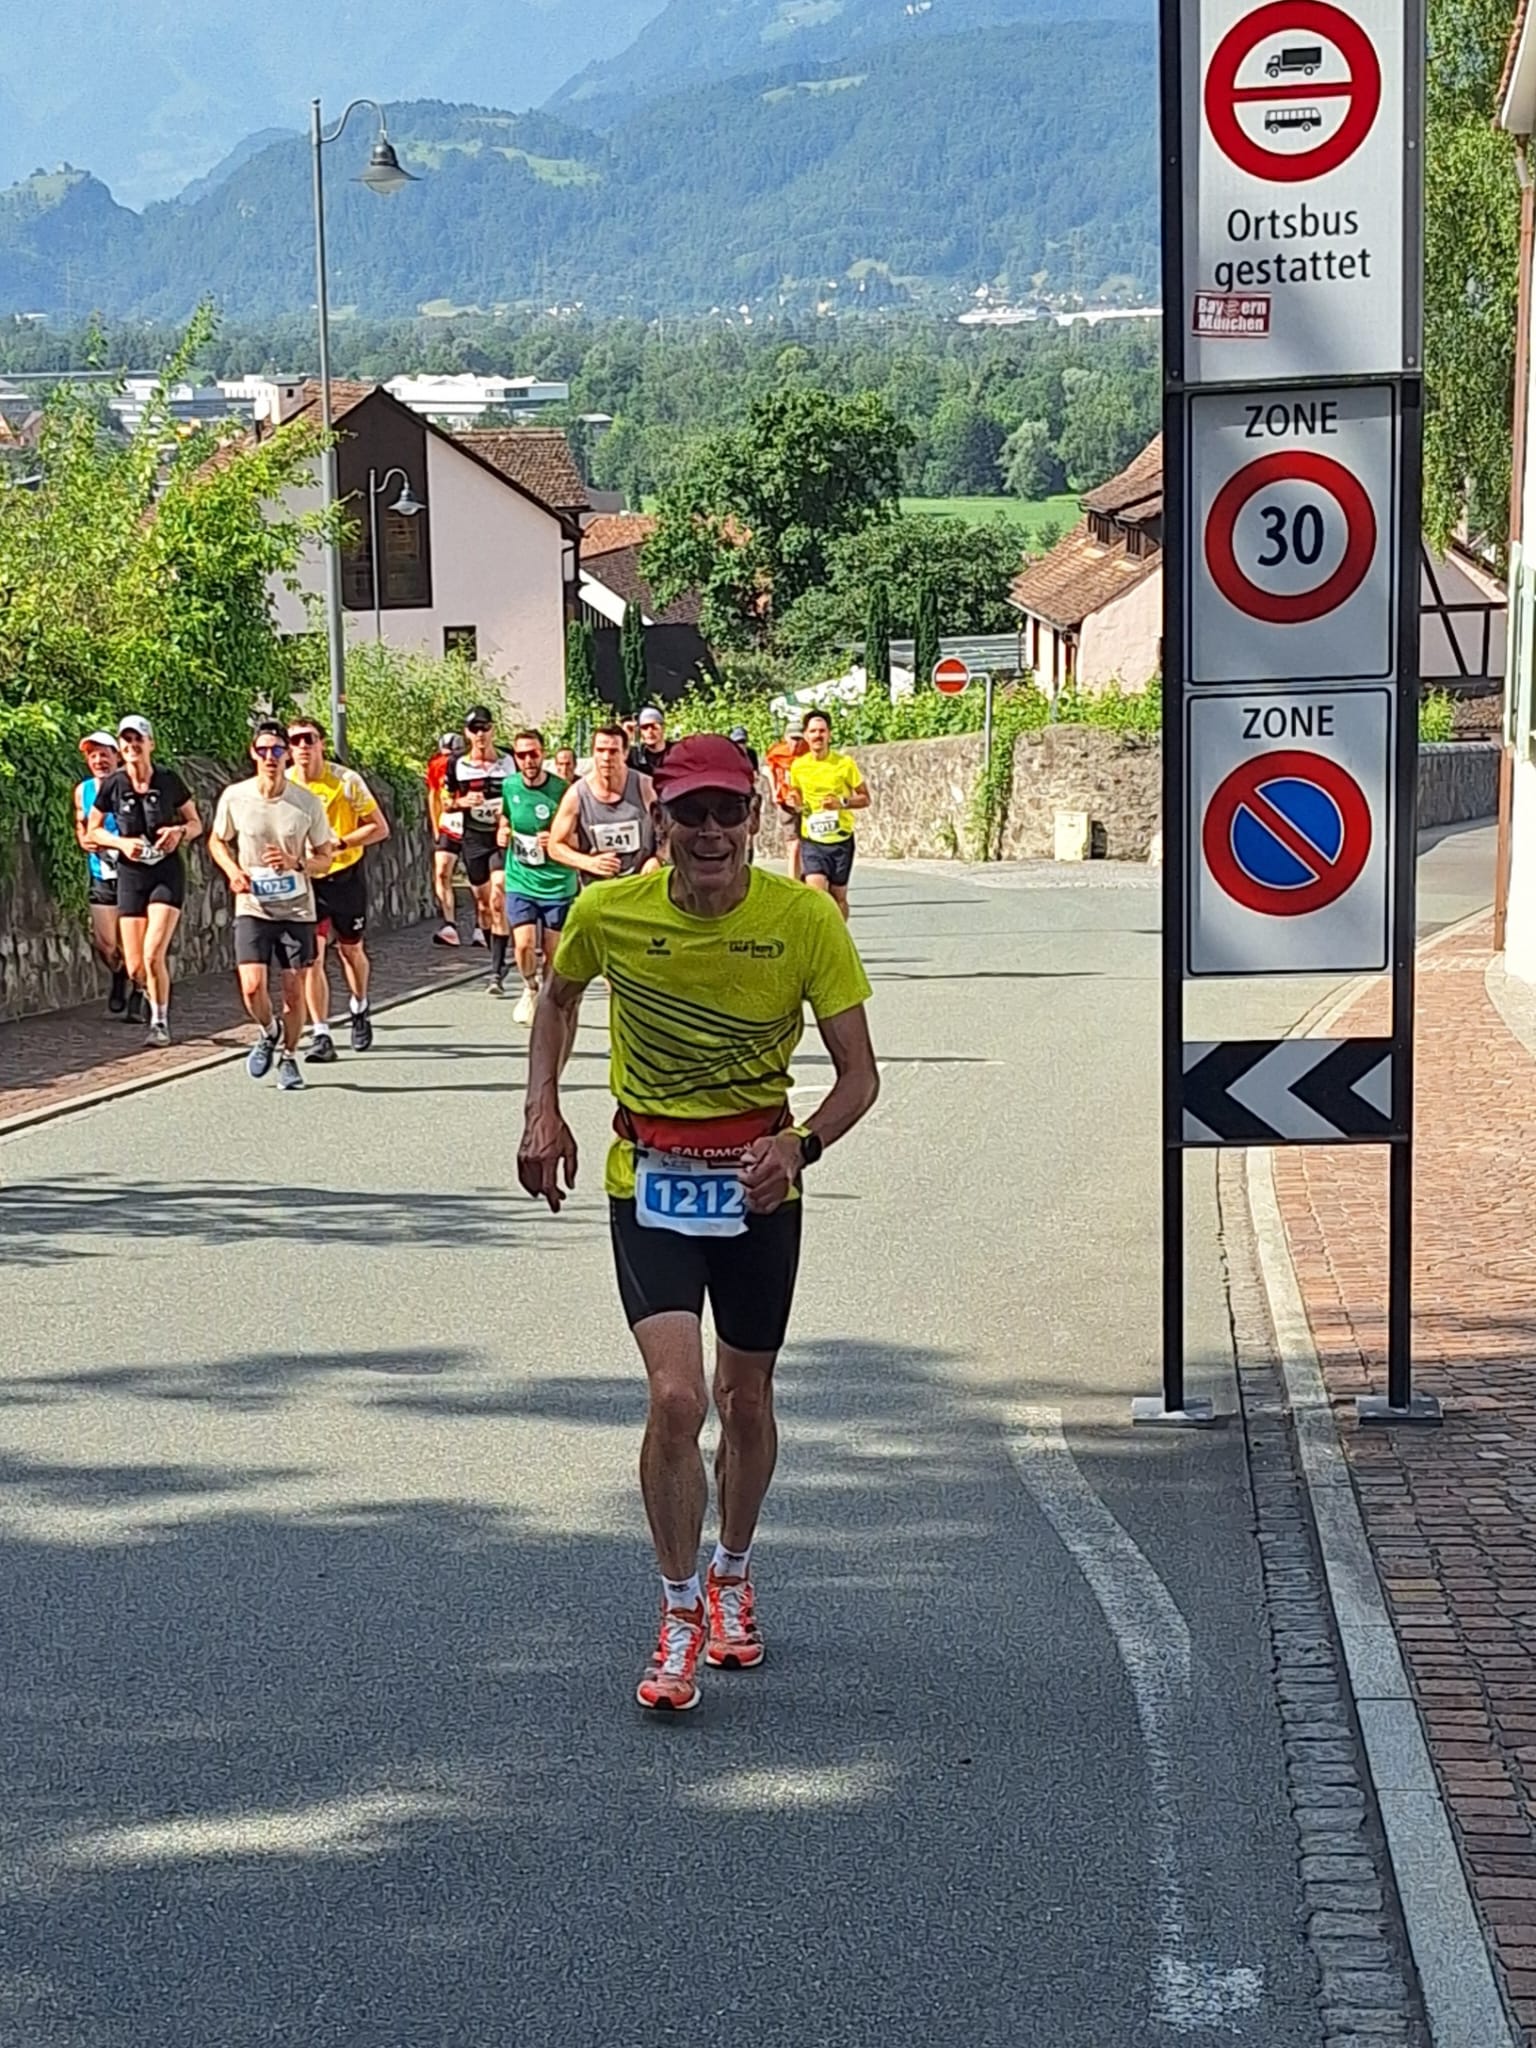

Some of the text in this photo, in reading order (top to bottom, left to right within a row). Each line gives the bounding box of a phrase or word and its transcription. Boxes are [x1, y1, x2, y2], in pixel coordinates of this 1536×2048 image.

[1227, 203, 1358, 242] Ortsbus
[1215, 248, 1371, 293] gestattet
[1245, 401, 1338, 438] ZONE
[1257, 504, 1325, 567] 30
[1242, 705, 1334, 739] ZONE
[604, 833, 631, 847] 241
[654, 1179, 745, 1214] 1212
